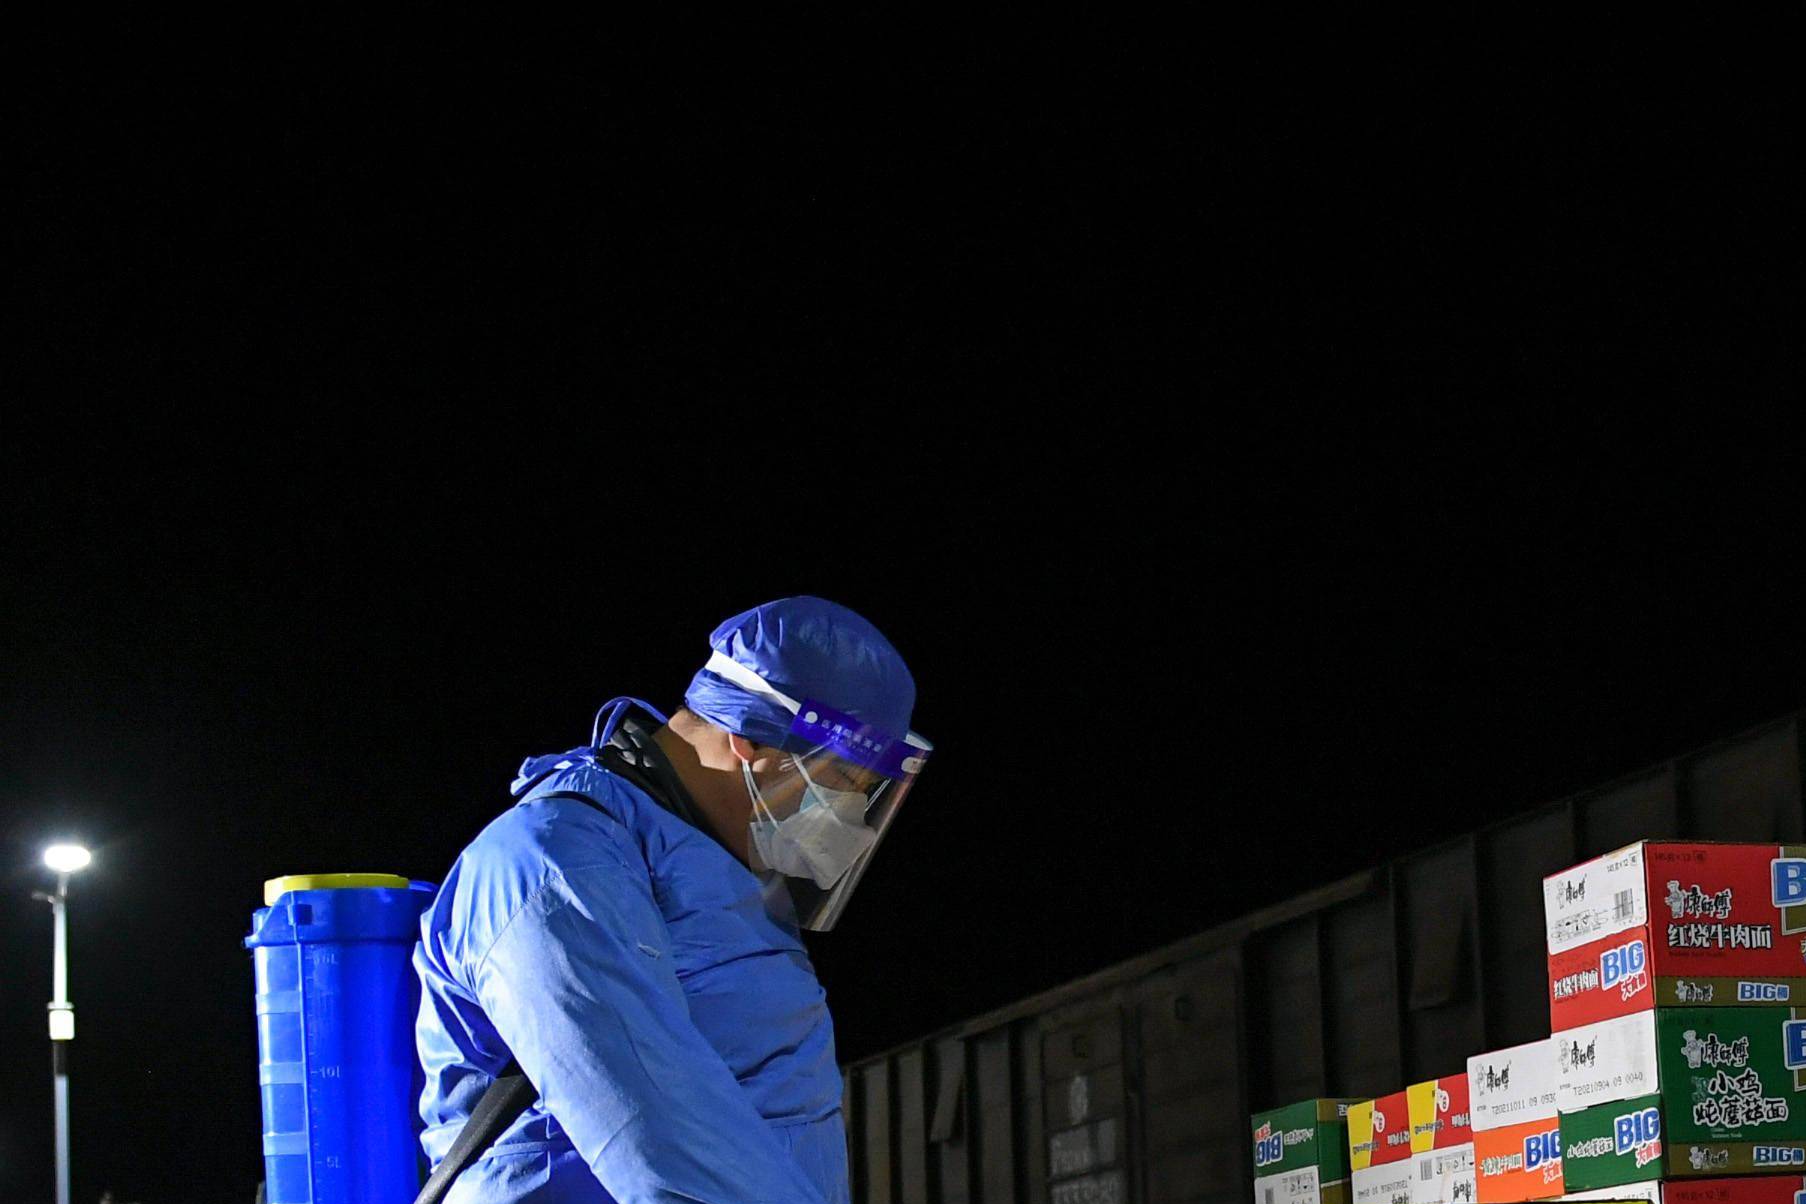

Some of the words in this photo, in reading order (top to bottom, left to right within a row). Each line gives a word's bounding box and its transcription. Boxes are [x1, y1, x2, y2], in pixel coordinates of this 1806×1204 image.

[1667, 923, 1773, 950] 红烧牛肉面
[1601, 939, 1646, 991] BIG
[1708, 1072, 1761, 1096] 小鸡
[1694, 1098, 1789, 1128] 炖蘑菇面
[1615, 1106, 1661, 1154] BIG
